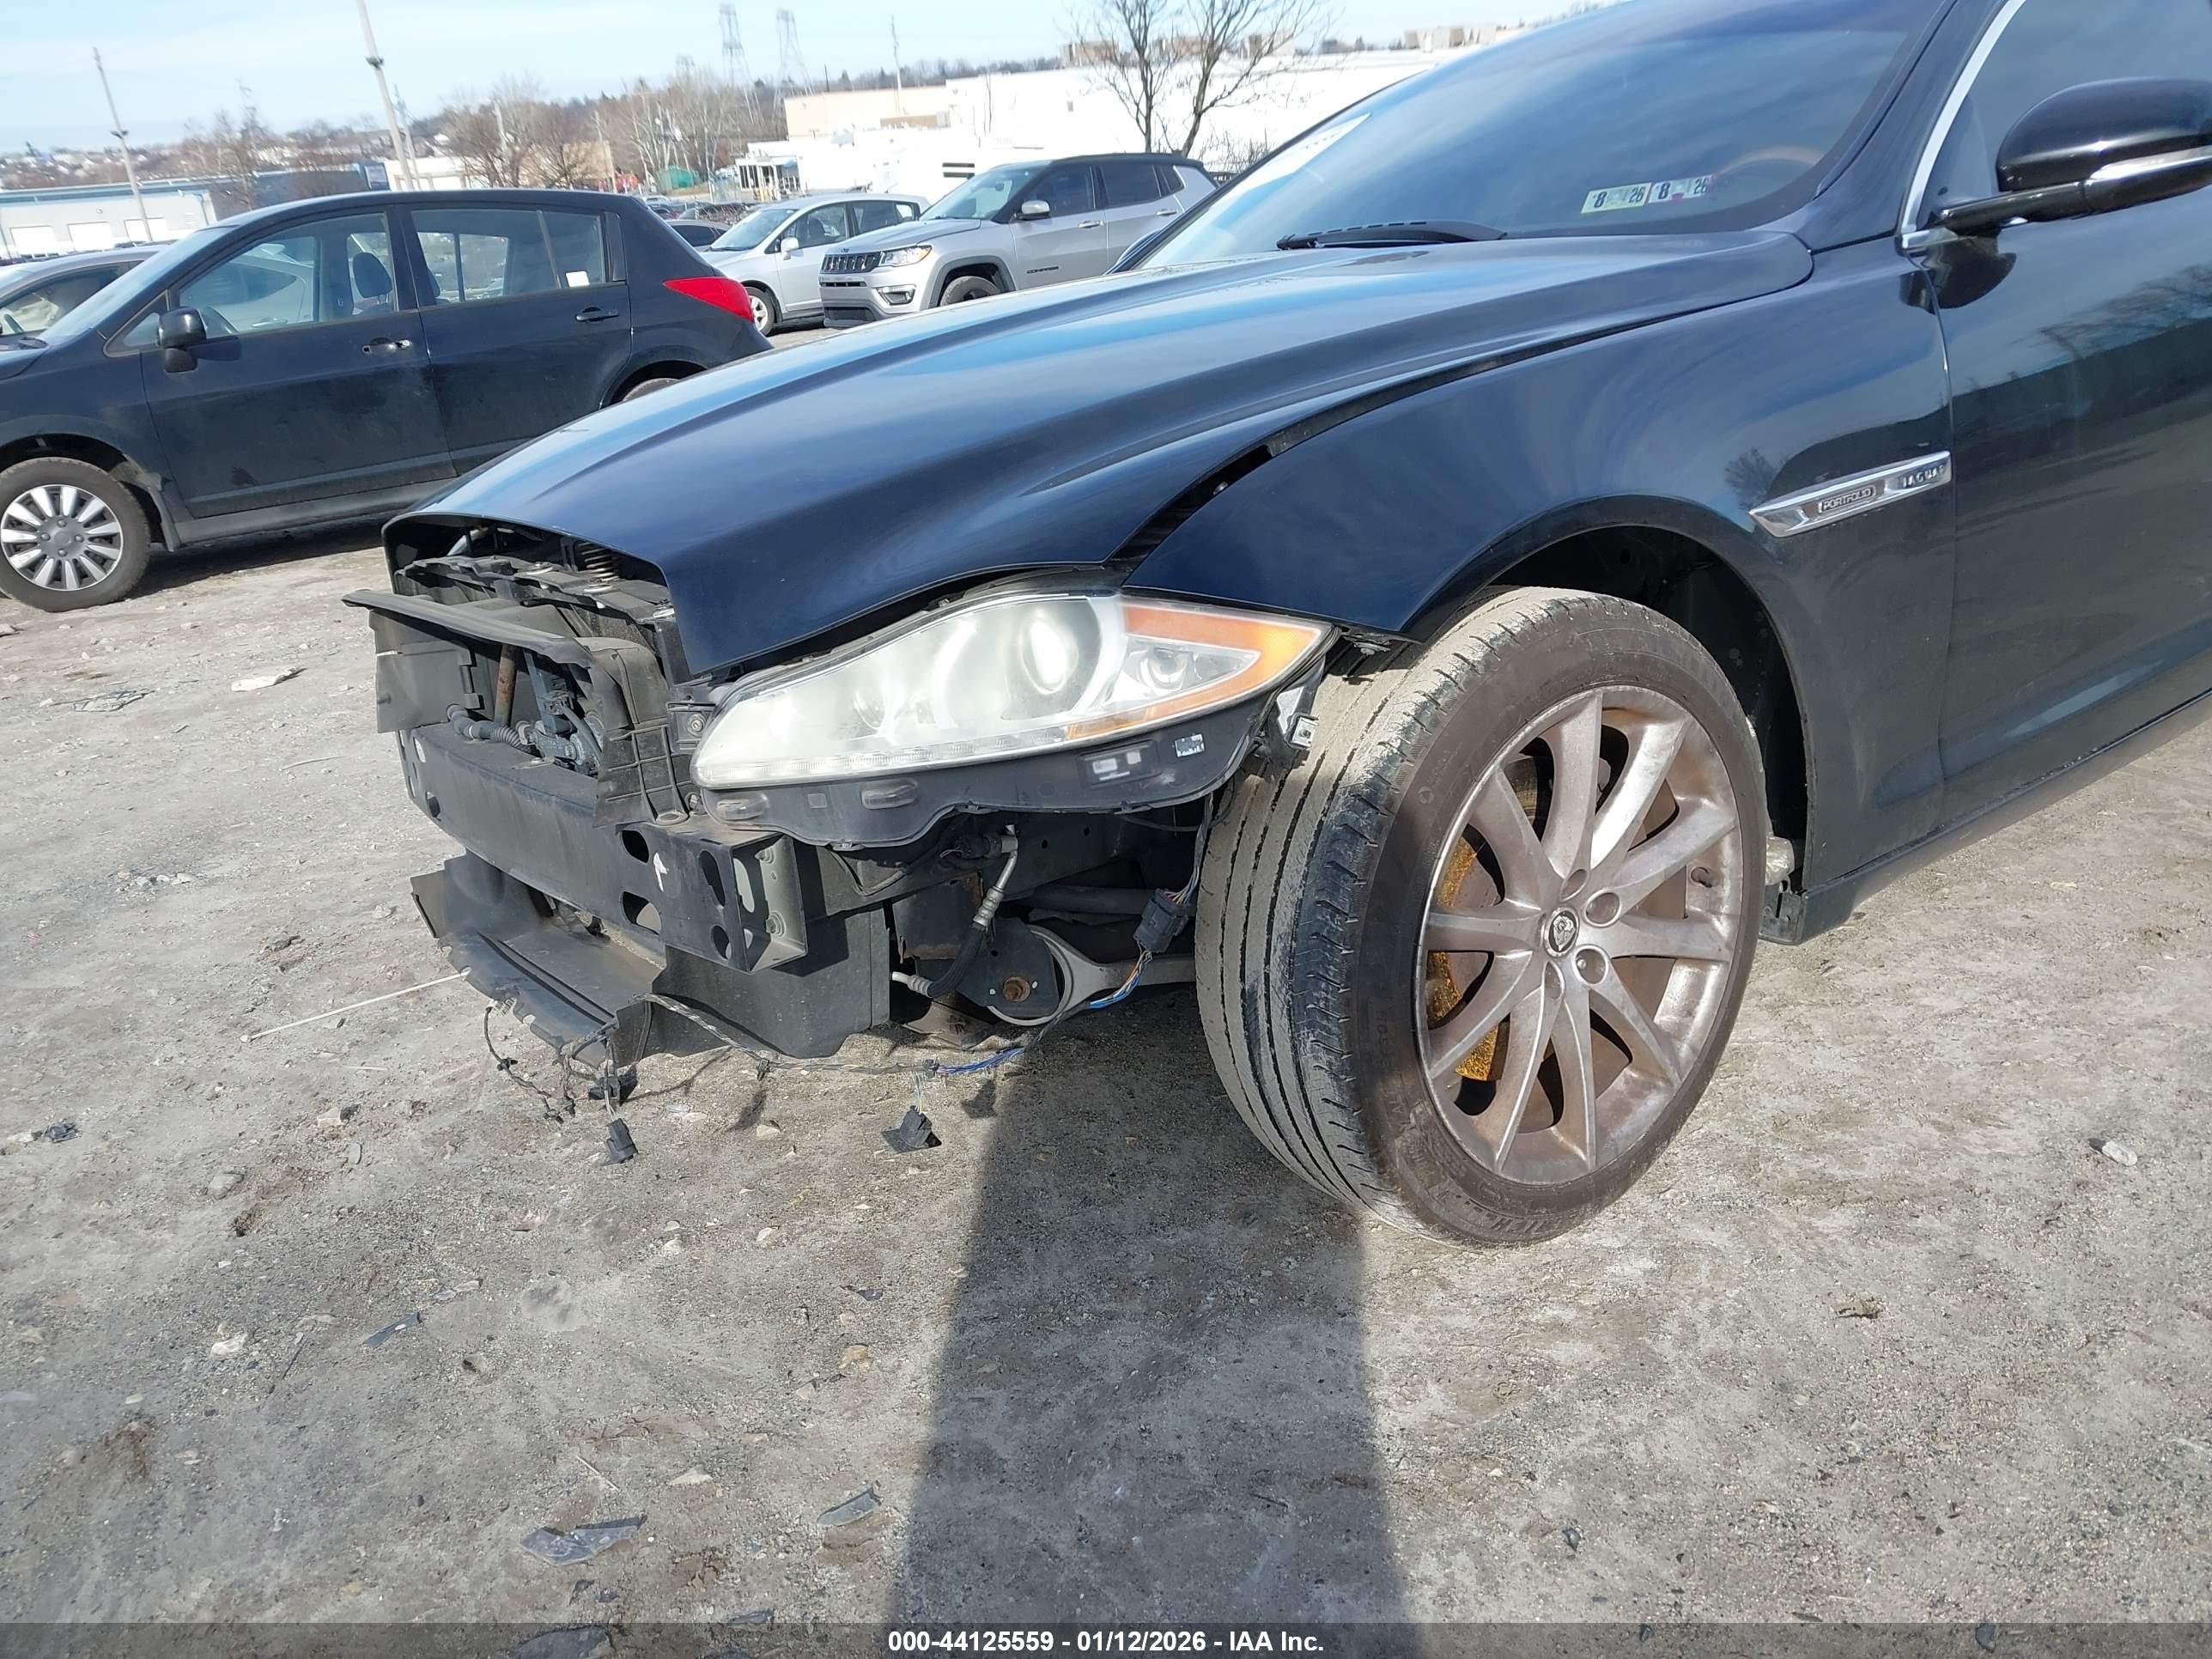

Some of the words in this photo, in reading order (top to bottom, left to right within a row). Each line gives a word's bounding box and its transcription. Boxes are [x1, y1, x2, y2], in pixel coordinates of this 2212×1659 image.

[1593, 191, 1608, 209] 8
[1628, 185, 1646, 204] 26
[1657, 182, 1671, 200] 8
[1902, 465, 1946, 488] JAGUAR
[1823, 488, 1872, 510] PORTFOLIO
